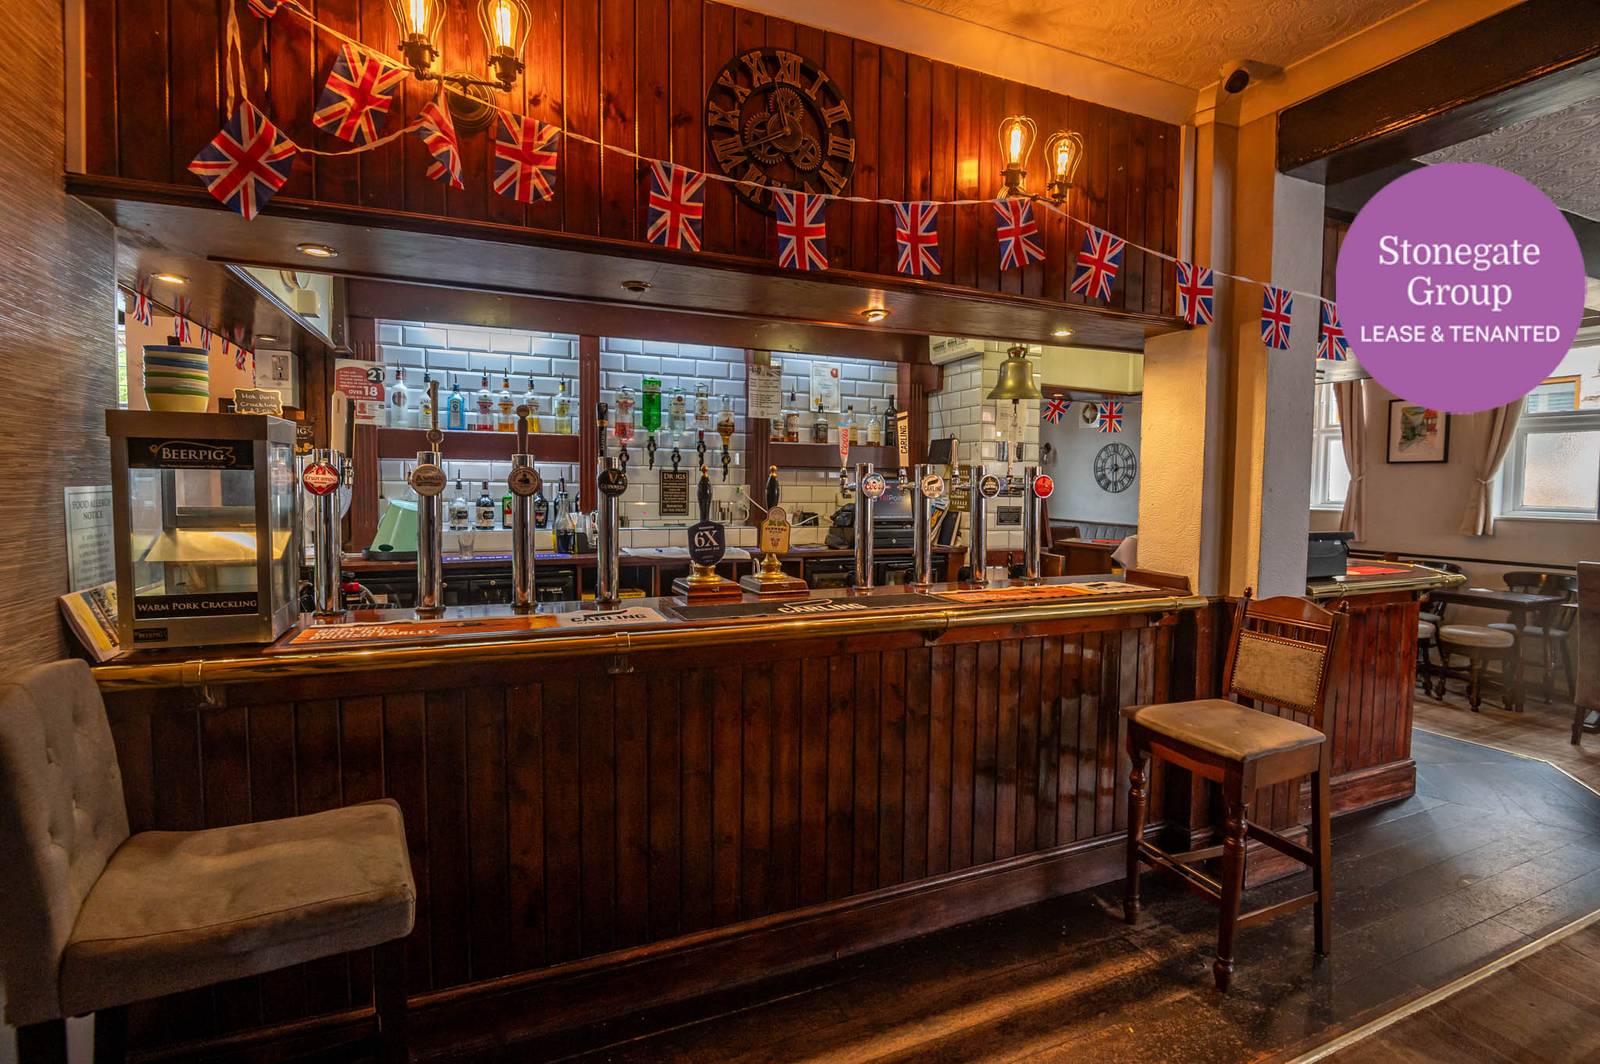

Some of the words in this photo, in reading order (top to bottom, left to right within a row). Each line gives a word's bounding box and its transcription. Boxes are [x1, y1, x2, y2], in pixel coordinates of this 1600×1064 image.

[367, 369, 384, 381] 21
[363, 386, 378, 396] 18
[899, 425, 908, 454] CARLING
[72, 500, 89, 510] FOOD
[83, 510, 104, 520] NOTICE
[694, 530, 720, 548] 6X
[137, 603, 169, 612] WARM
[172, 602, 199, 611] PORK
[201, 599, 257, 609] CRACKLING
[571, 613, 647, 622] CARLING
